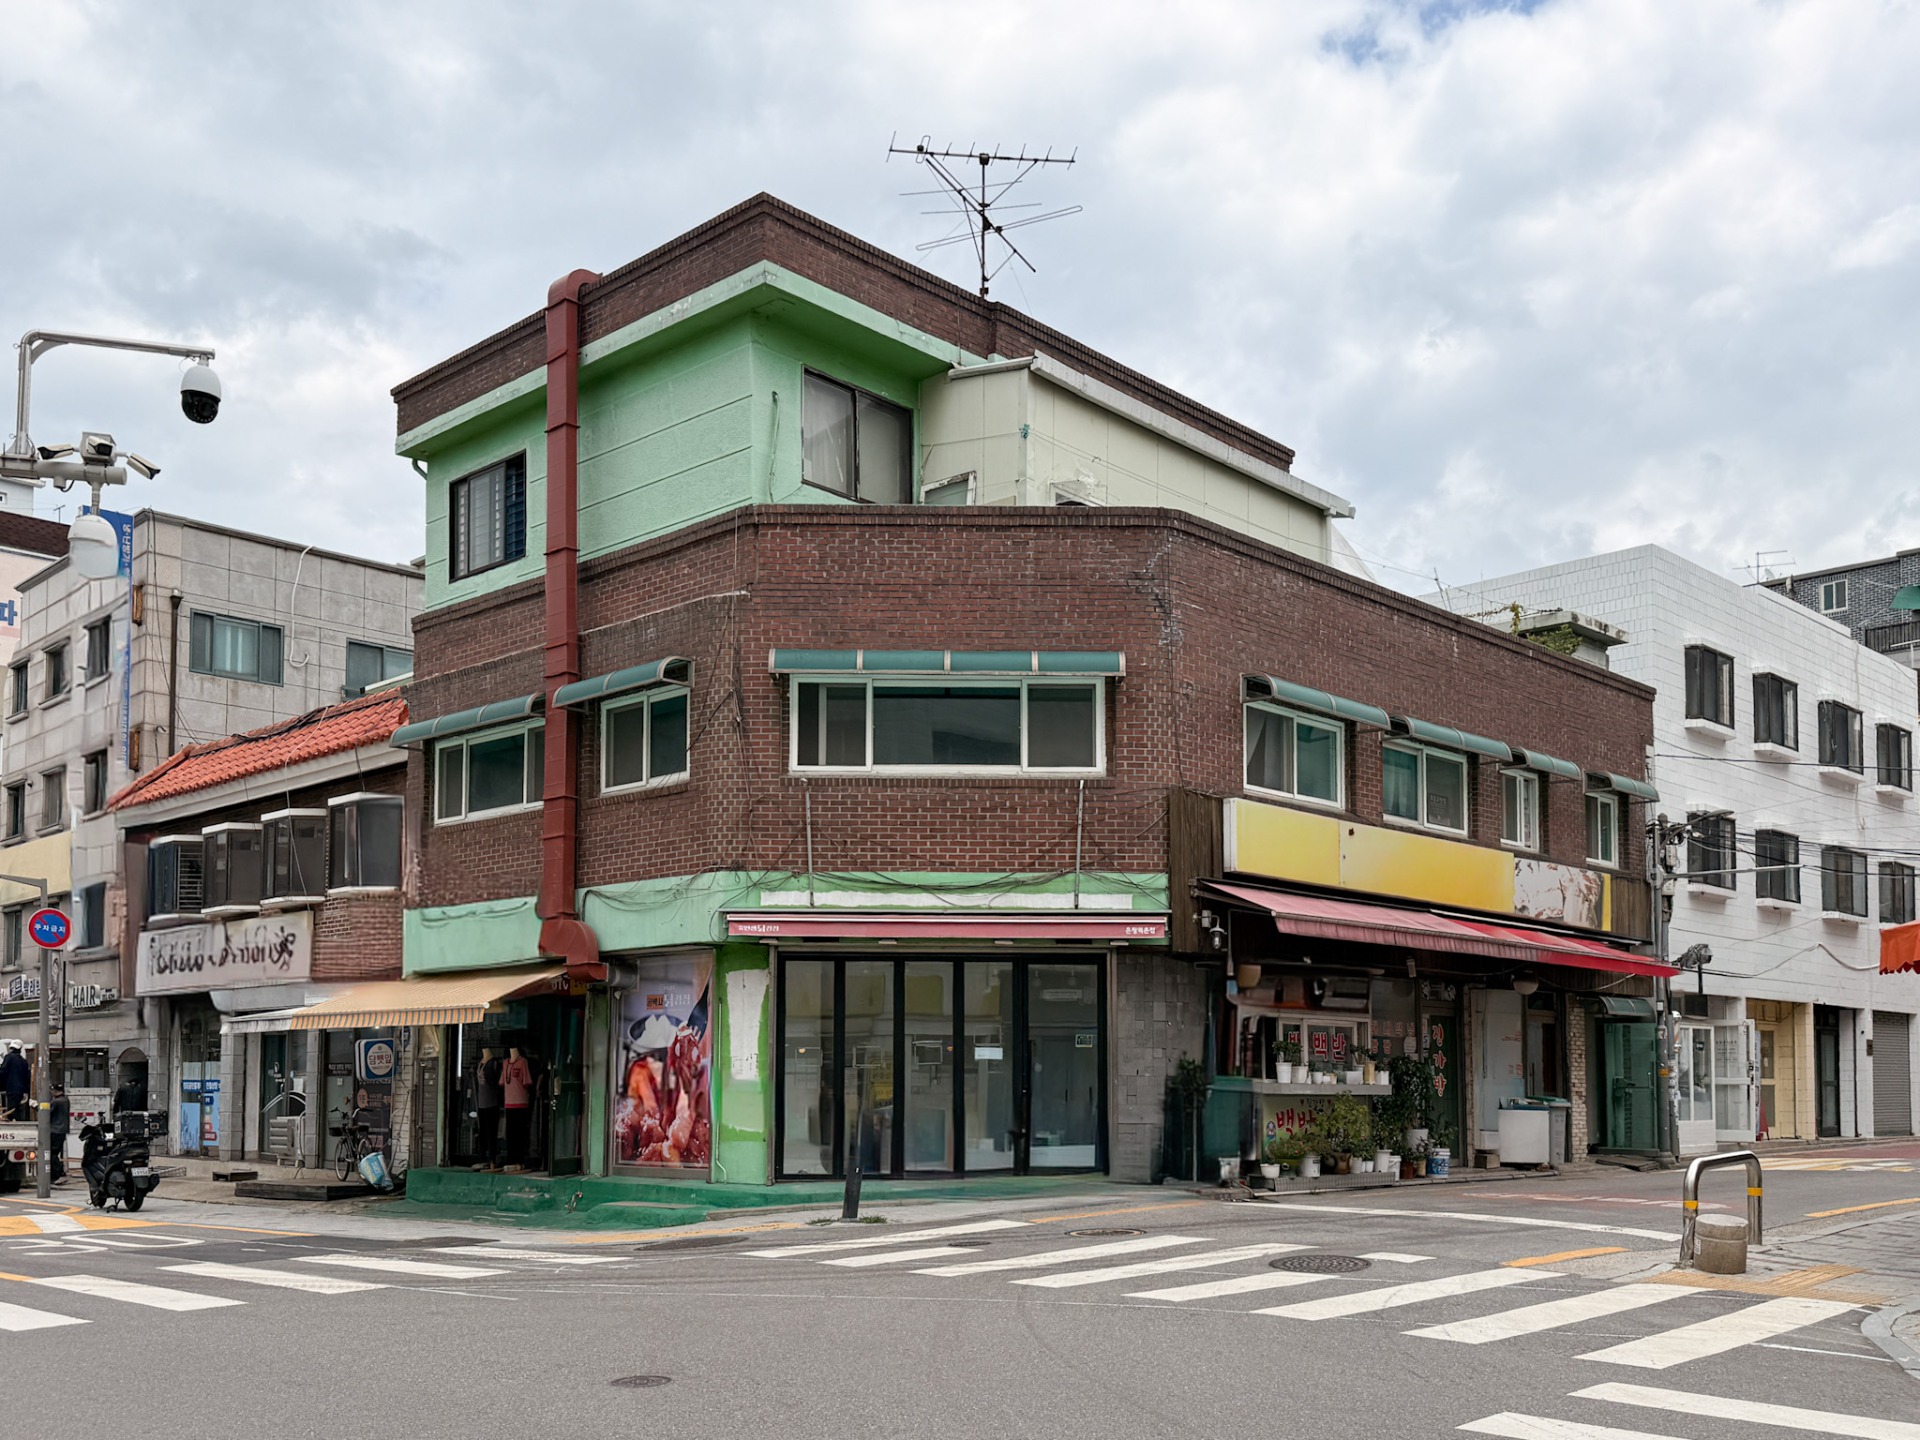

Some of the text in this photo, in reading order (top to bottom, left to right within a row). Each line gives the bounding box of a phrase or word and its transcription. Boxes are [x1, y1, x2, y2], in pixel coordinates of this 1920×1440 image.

[34, 923, 66, 933] 주차금지
[72, 985, 96, 1008] HAIR
[1312, 1031, 1347, 1062] 백반
[0, 1132, 15, 1141] RS
